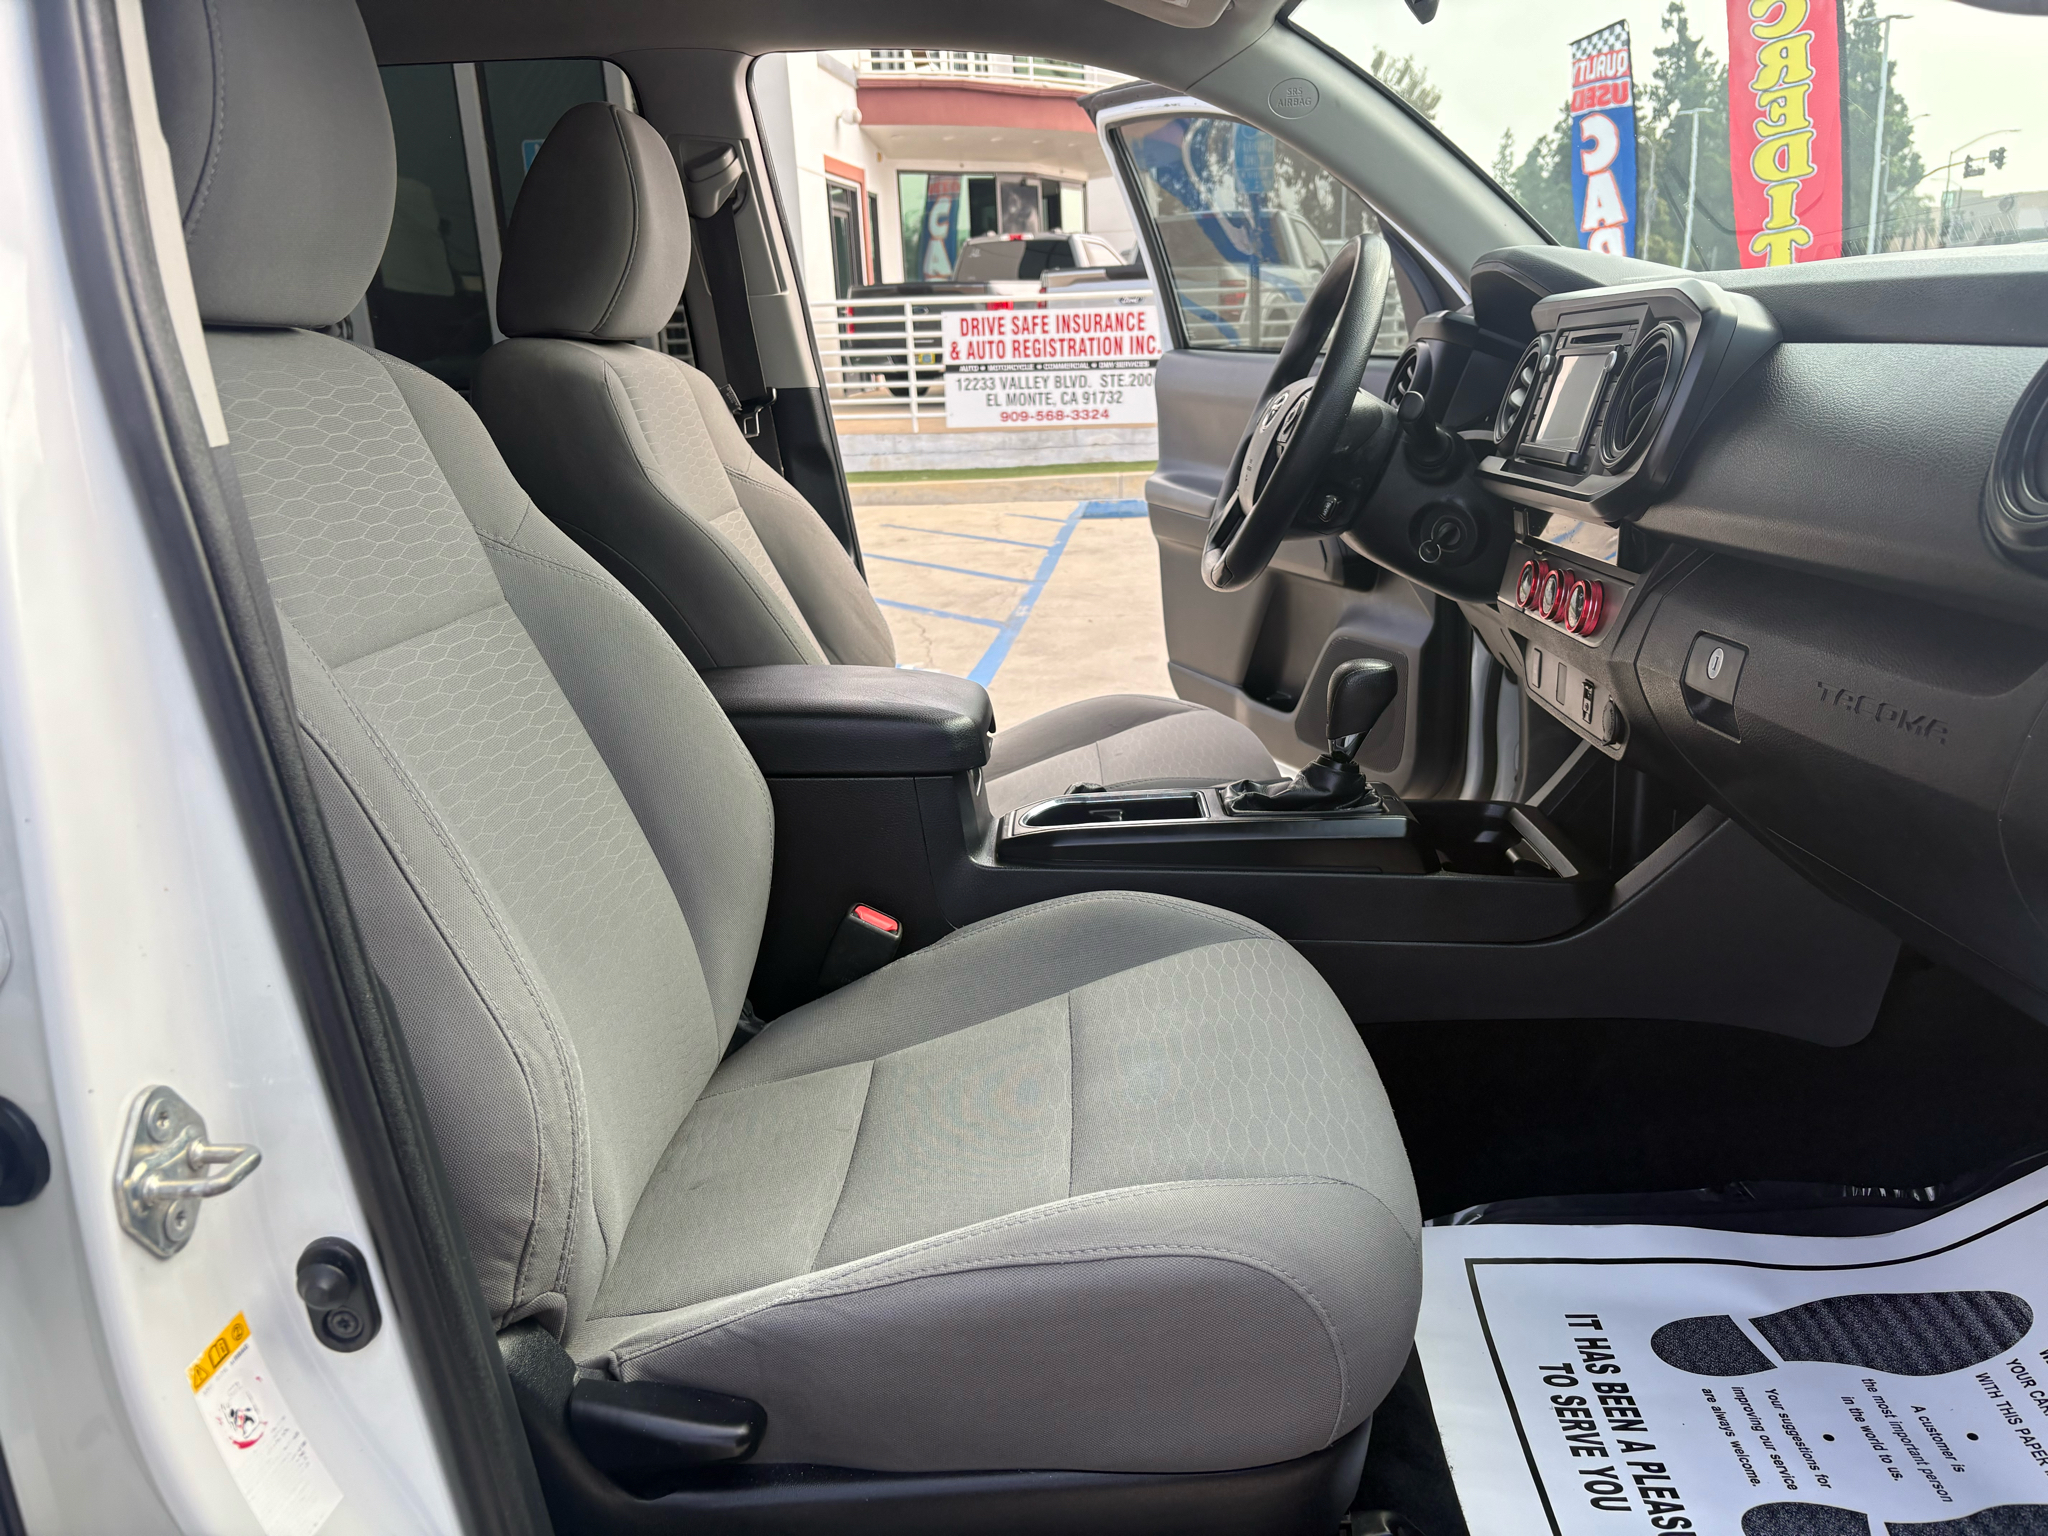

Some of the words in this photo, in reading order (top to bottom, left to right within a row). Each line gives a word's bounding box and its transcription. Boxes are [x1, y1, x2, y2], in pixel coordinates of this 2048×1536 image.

[1277, 97, 1312, 107] AIRBAG
[1286, 87, 1303, 96] SRS
[960, 316, 1005, 337] DRIVE
[1012, 315, 1049, 335] SAFE
[1056, 312, 1146, 334] INSURANCE
[950, 341, 960, 361] &
[966, 339, 1006, 360] AUTO
[1012, 336, 1123, 359] REGISTRATION
[1129, 335, 1163, 356] INC.
[957, 377, 996, 391] 12233
[999, 375, 1050, 390] VALLEY
[1054, 374, 1092, 389] BLVD.
[986, 393, 1002, 407] EL
[1006, 392, 1057, 407] MONTE,
[1060, 391, 1079, 406] CA
[1082, 391, 1124, 405] 91732
[1000, 409, 1110, 422] 909-568-3324
[1817, 681, 1949, 745] TACOMA
[1564, 1314, 1603, 1330] IT
[1538, 1362, 1579, 1387] TO
[1573, 1338, 1621, 1375] HAS
[2006, 1358, 2037, 1389] YOUR
[1550, 1394, 1610, 1457] SERVE
[1591, 1382, 1648, 1432] BEEN
[1975, 1371, 2004, 1400] WITH
[1996, 1400, 2023, 1425] THIS
[2014, 1427, 2048, 1467] PAPER
[1616, 1439, 1657, 1453] A
[1701, 1388, 1717, 1403] are
[1711, 1405, 1736, 1438] always
[1730, 1440, 1761, 1487] welcome.
[1731, 1386, 1765, 1432] improving
[1759, 1434, 1777, 1452] our
[1770, 1454, 1798, 1491] service
[1765, 1388, 1785, 1411] Your
[1779, 1412, 1820, 1471] suggestions
[1815, 1474, 1832, 1489] for
[1840, 1396, 1855, 1405] in
[1848, 1407, 1866, 1422] the
[1860, 1425, 1889, 1451] world
[1878, 1454, 1893, 1464] to
[1887, 1466, 1904, 1481] us.
[1861, 1378, 1878, 1393] the
[1872, 1395, 1898, 1419] most
[1889, 1421, 1930, 1466] important
[1917, 1468, 1953, 1503] person
[1910, 1405, 1926, 1413] A
[1918, 1416, 1958, 1461] customer
[1950, 1463, 1966, 1473] is
[1578, 1465, 1632, 1511] YOU
